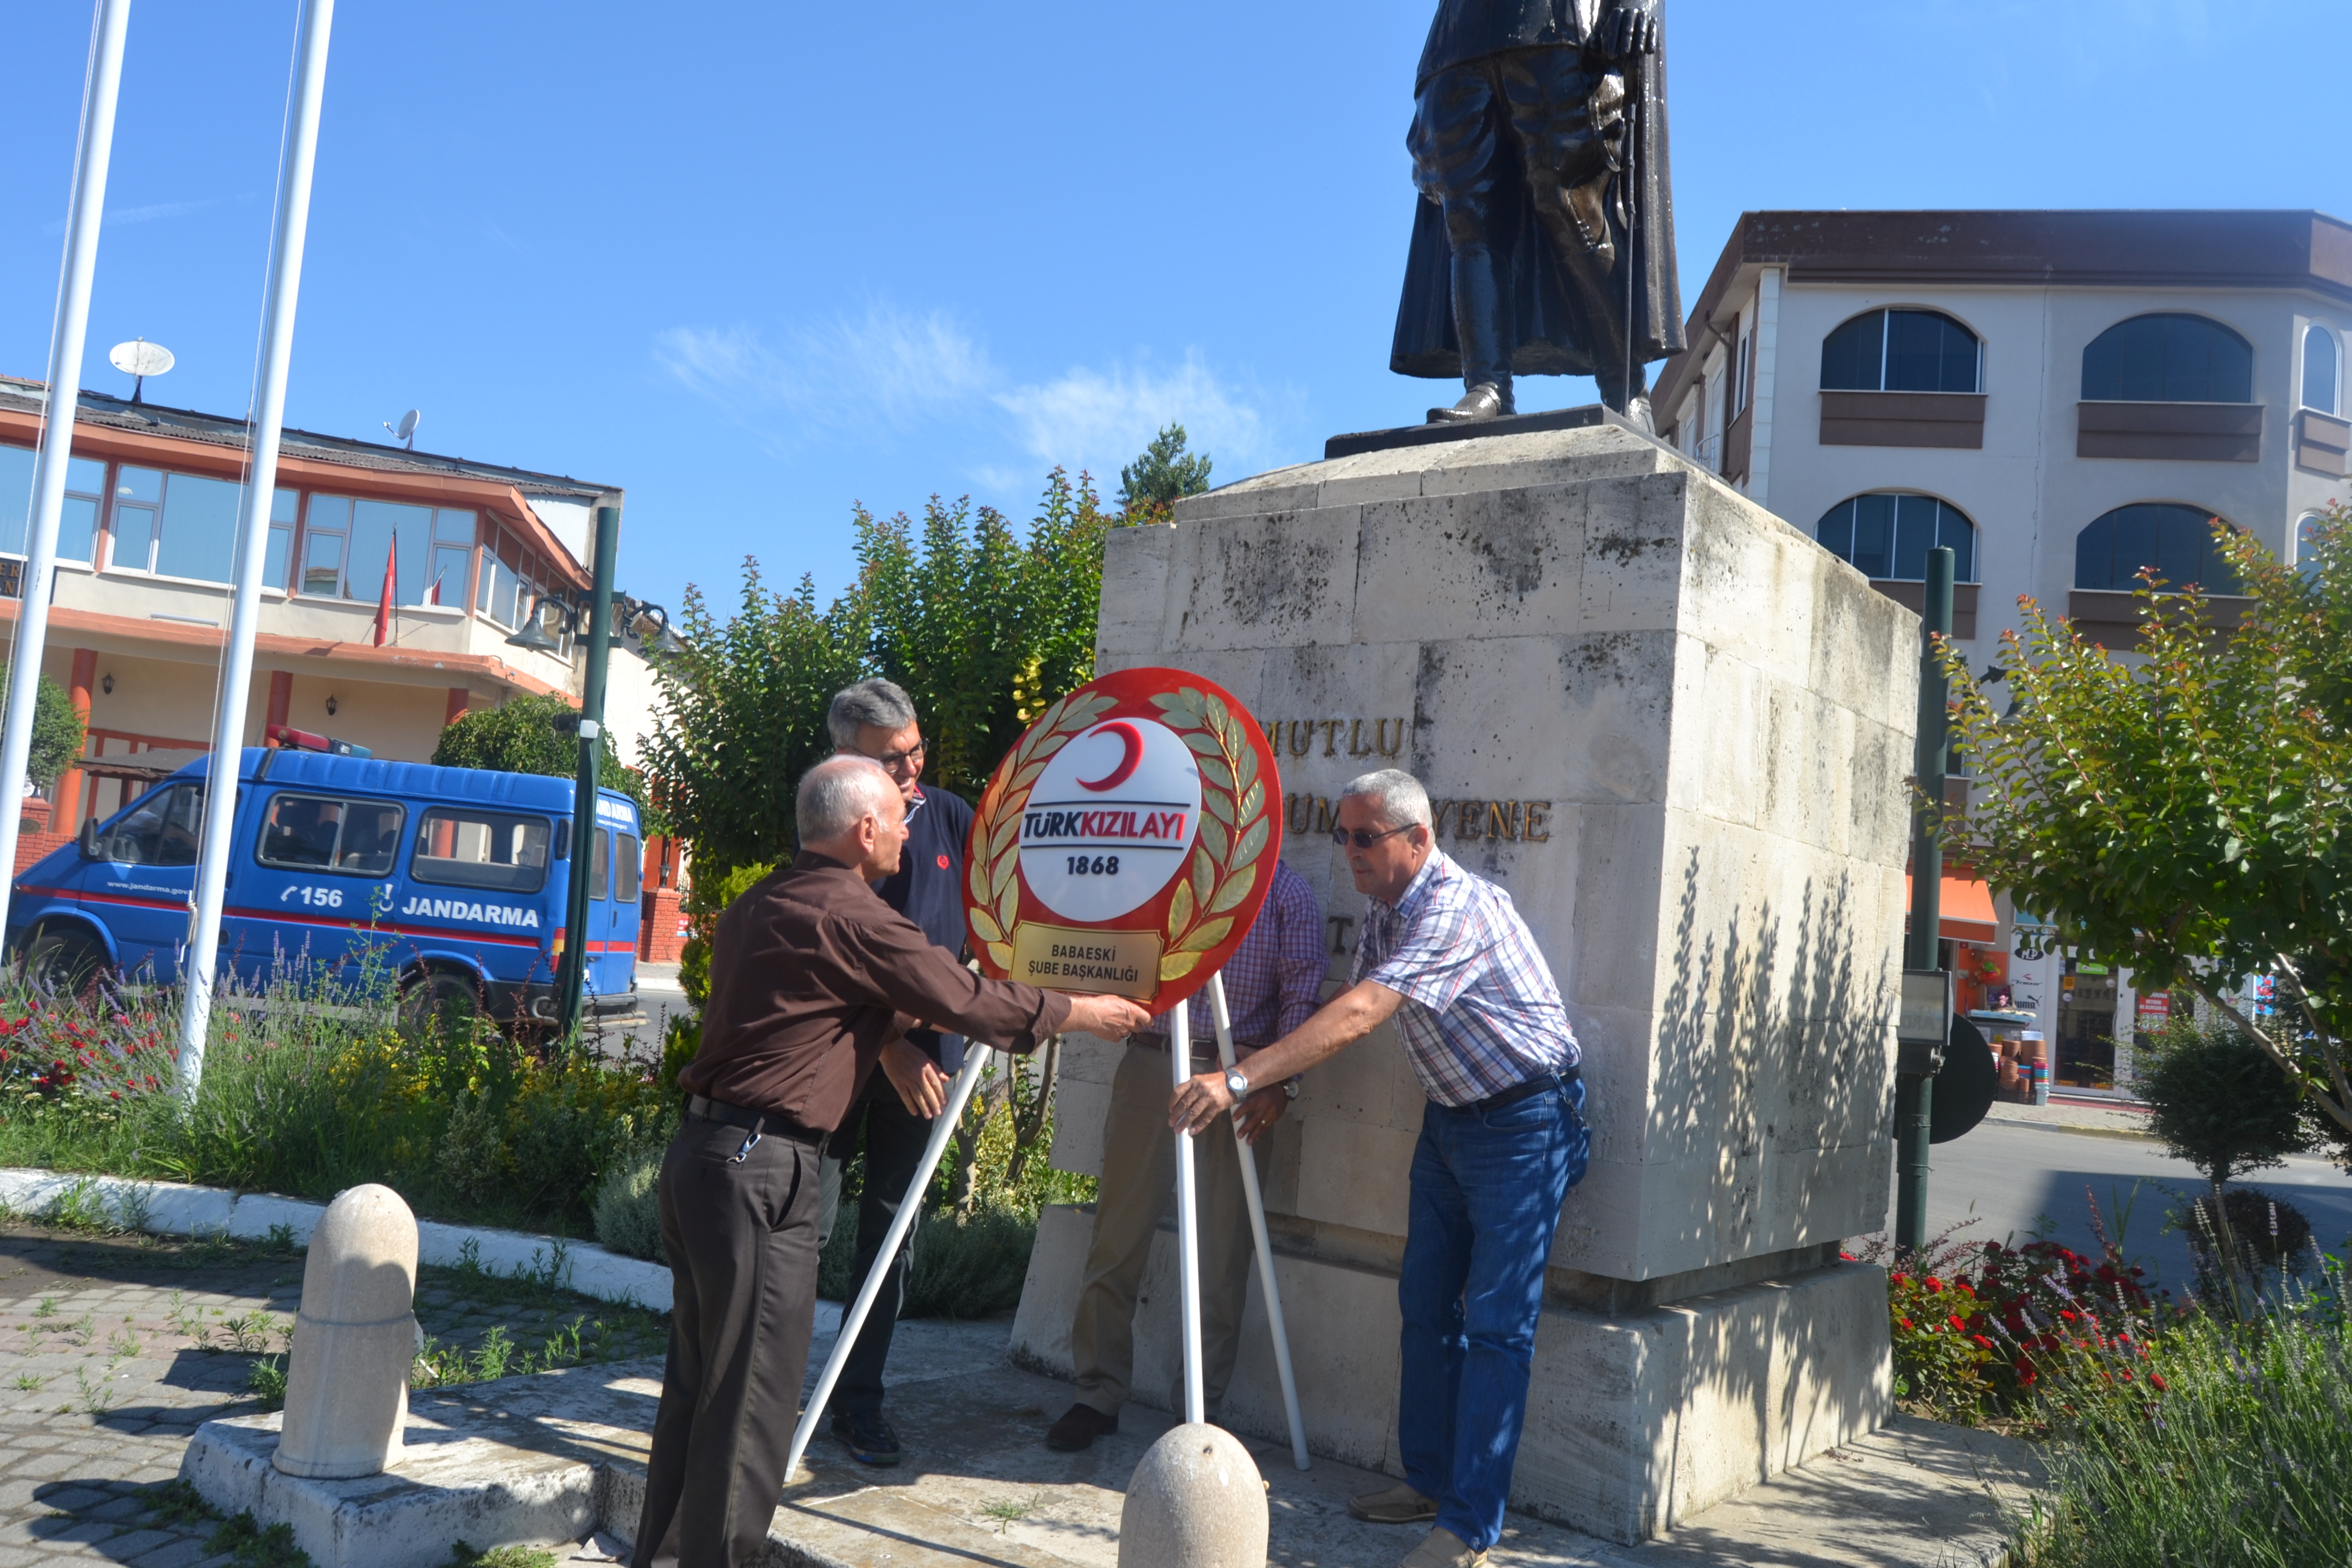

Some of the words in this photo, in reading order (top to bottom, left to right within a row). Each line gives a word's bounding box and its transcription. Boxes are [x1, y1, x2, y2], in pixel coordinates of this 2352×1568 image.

[1429, 800, 1551, 843] YENE
[1067, 855, 1119, 875] 1868
[300, 886, 343, 908] 156
[402, 897, 540, 928] JANDARMA
[1051, 944, 1116, 962] BABAESKİ
[1028, 960, 1059, 977] ŞUBE
[1062, 964, 1138, 983] BAŞKANLIĞI
